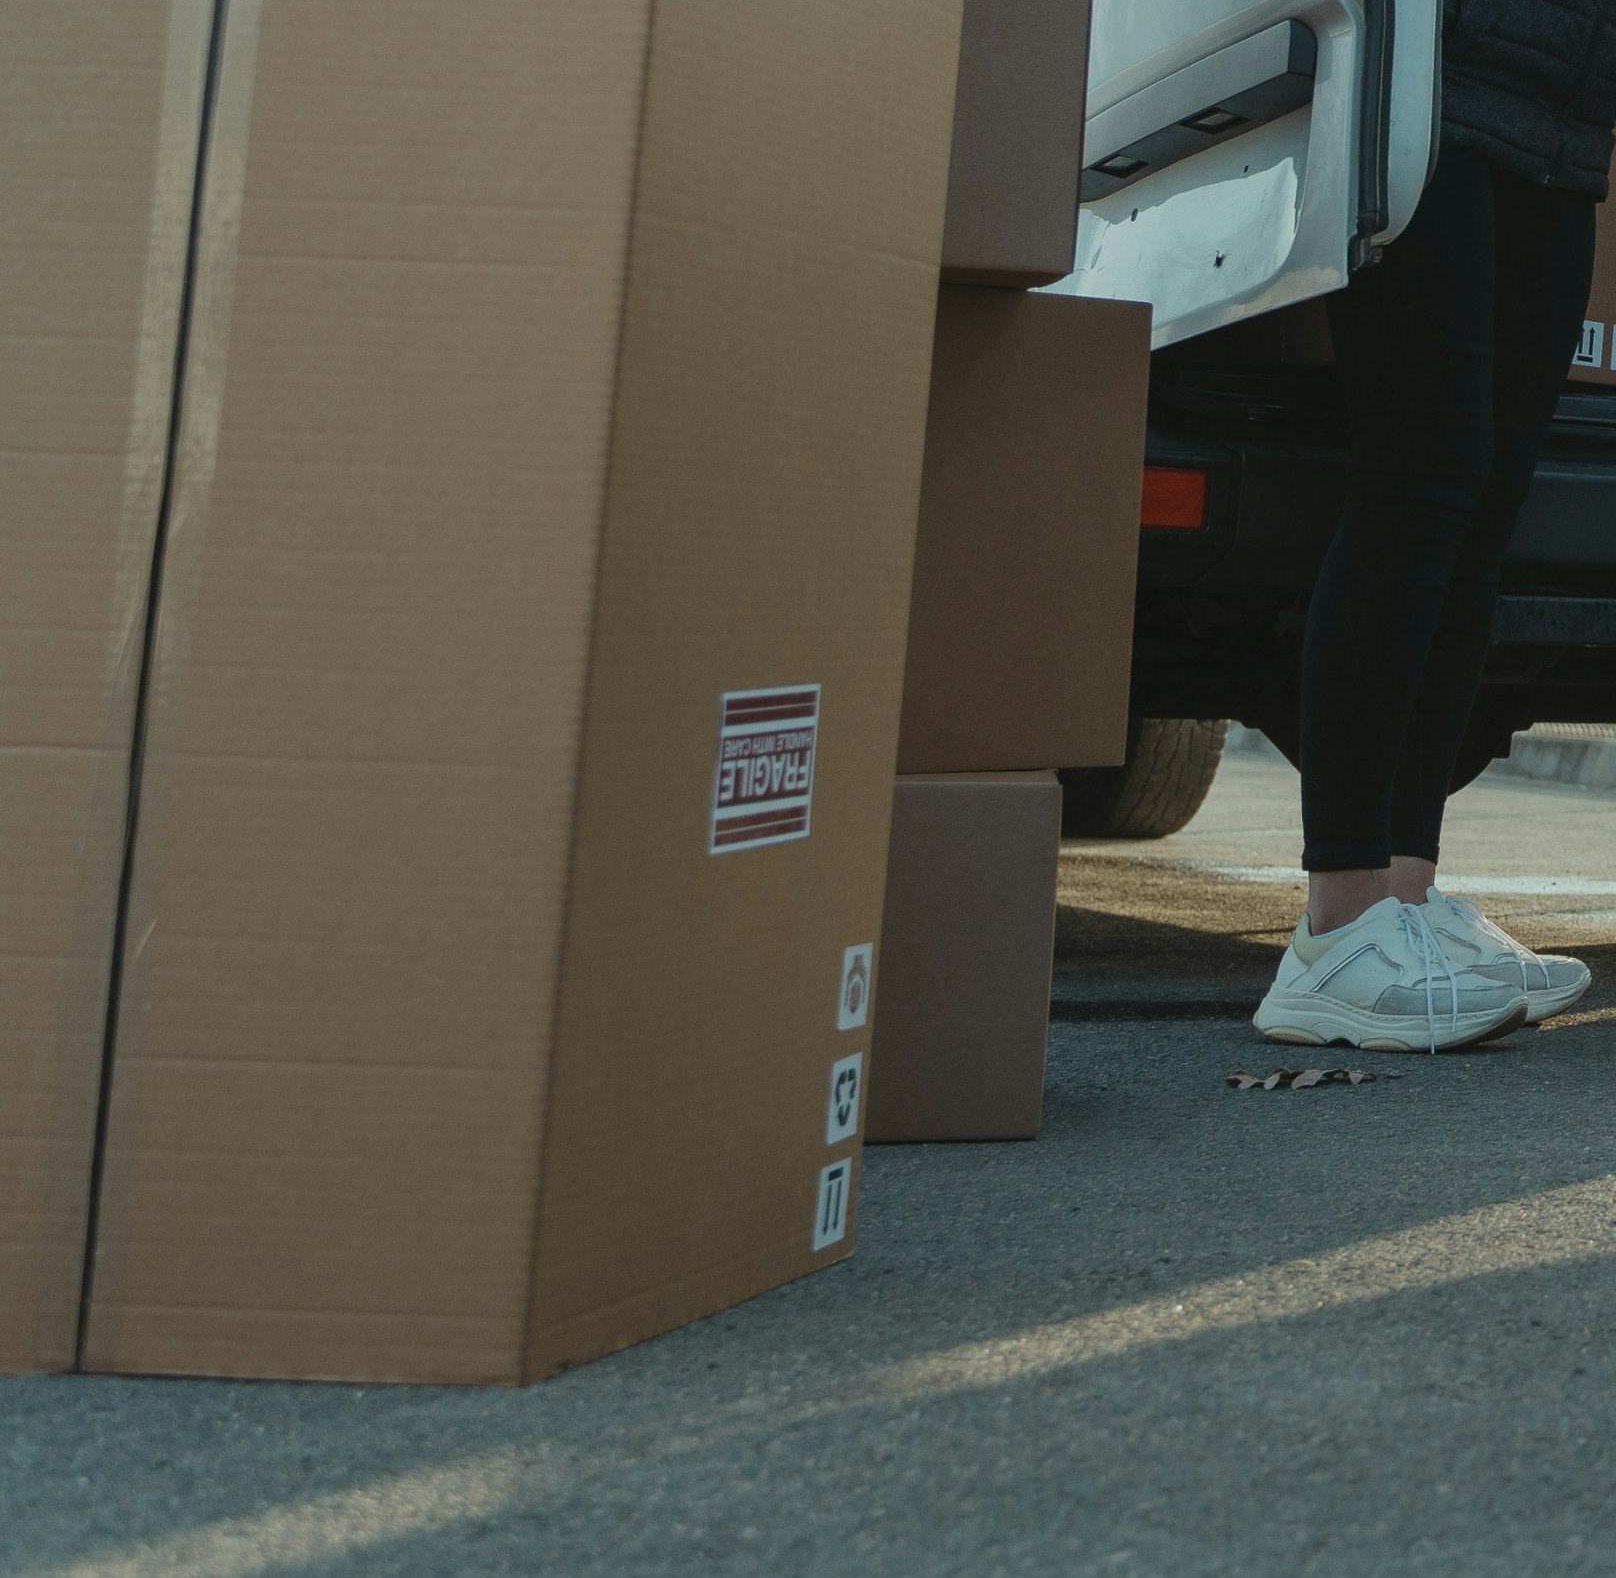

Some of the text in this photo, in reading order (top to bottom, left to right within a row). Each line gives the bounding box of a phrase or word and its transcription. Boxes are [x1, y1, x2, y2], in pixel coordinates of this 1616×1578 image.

[724, 730, 813, 758] HANDLE WITH CARE
[719, 750, 811, 802] FRAGILE
